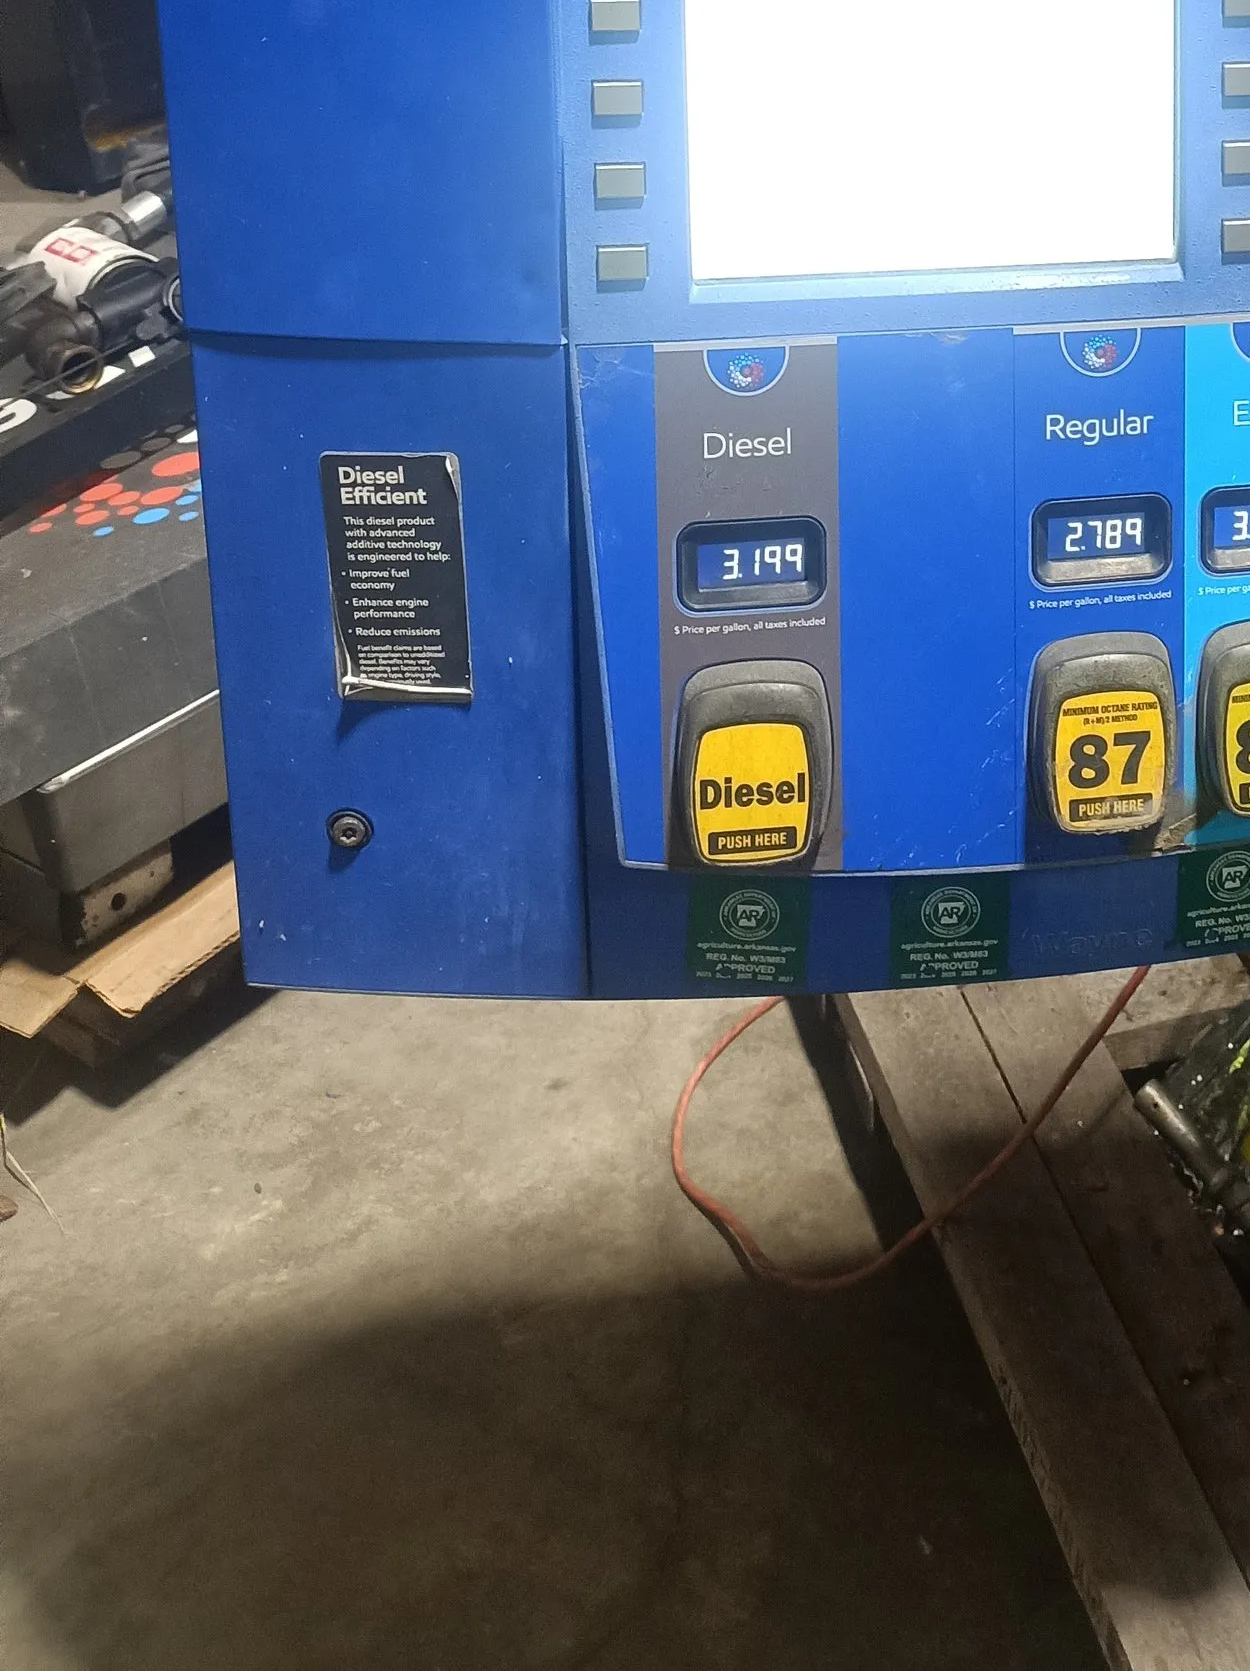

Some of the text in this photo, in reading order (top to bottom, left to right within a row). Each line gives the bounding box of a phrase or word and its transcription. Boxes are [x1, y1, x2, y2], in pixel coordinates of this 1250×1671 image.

[1045, 409, 1154, 446] Regular
[702, 427, 792, 460] Diesel
[337, 465, 405, 485] Diesel
[340, 486, 428, 506] Efficient
[343, 516, 436, 528] This diesel product
[345, 528, 416, 538] with advanced
[1064, 517, 1142, 553] 2.789
[346, 540, 442, 551] additive technology
[347, 552, 451, 563] is engineered to help:
[722, 543, 803, 580] 3.199
[349, 568, 410, 579] Improve fuel
[350, 581, 396, 592] economy
[1198, 586, 1205, 596] $
[1205, 585, 1226, 594] Price
[1227, 585, 1242, 595] per
[352, 597, 429, 609] Enhance engine
[1029, 590, 1173, 609] $ Price per gallon, all taxes included
[354, 609, 416, 620] performance
[355, 627, 441, 637] Reduce emissions
[674, 616, 826, 635] $ Price per gallon, all taxes included
[1062, 701, 1159, 717] MINIMUM OCTANE RATING
[1111, 714, 1138, 724] METHOD
[1068, 730, 1152, 789] 87
[699, 772, 806, 811] Diesel
[1078, 798, 1145, 817] PUSH HERE
[717, 831, 788, 850] PUSH HERE
[1195, 918, 1217, 928] REG.
[1218, 917, 1233, 925] No.
[705, 953, 729, 961] REG.
[731, 954, 746, 962] No.
